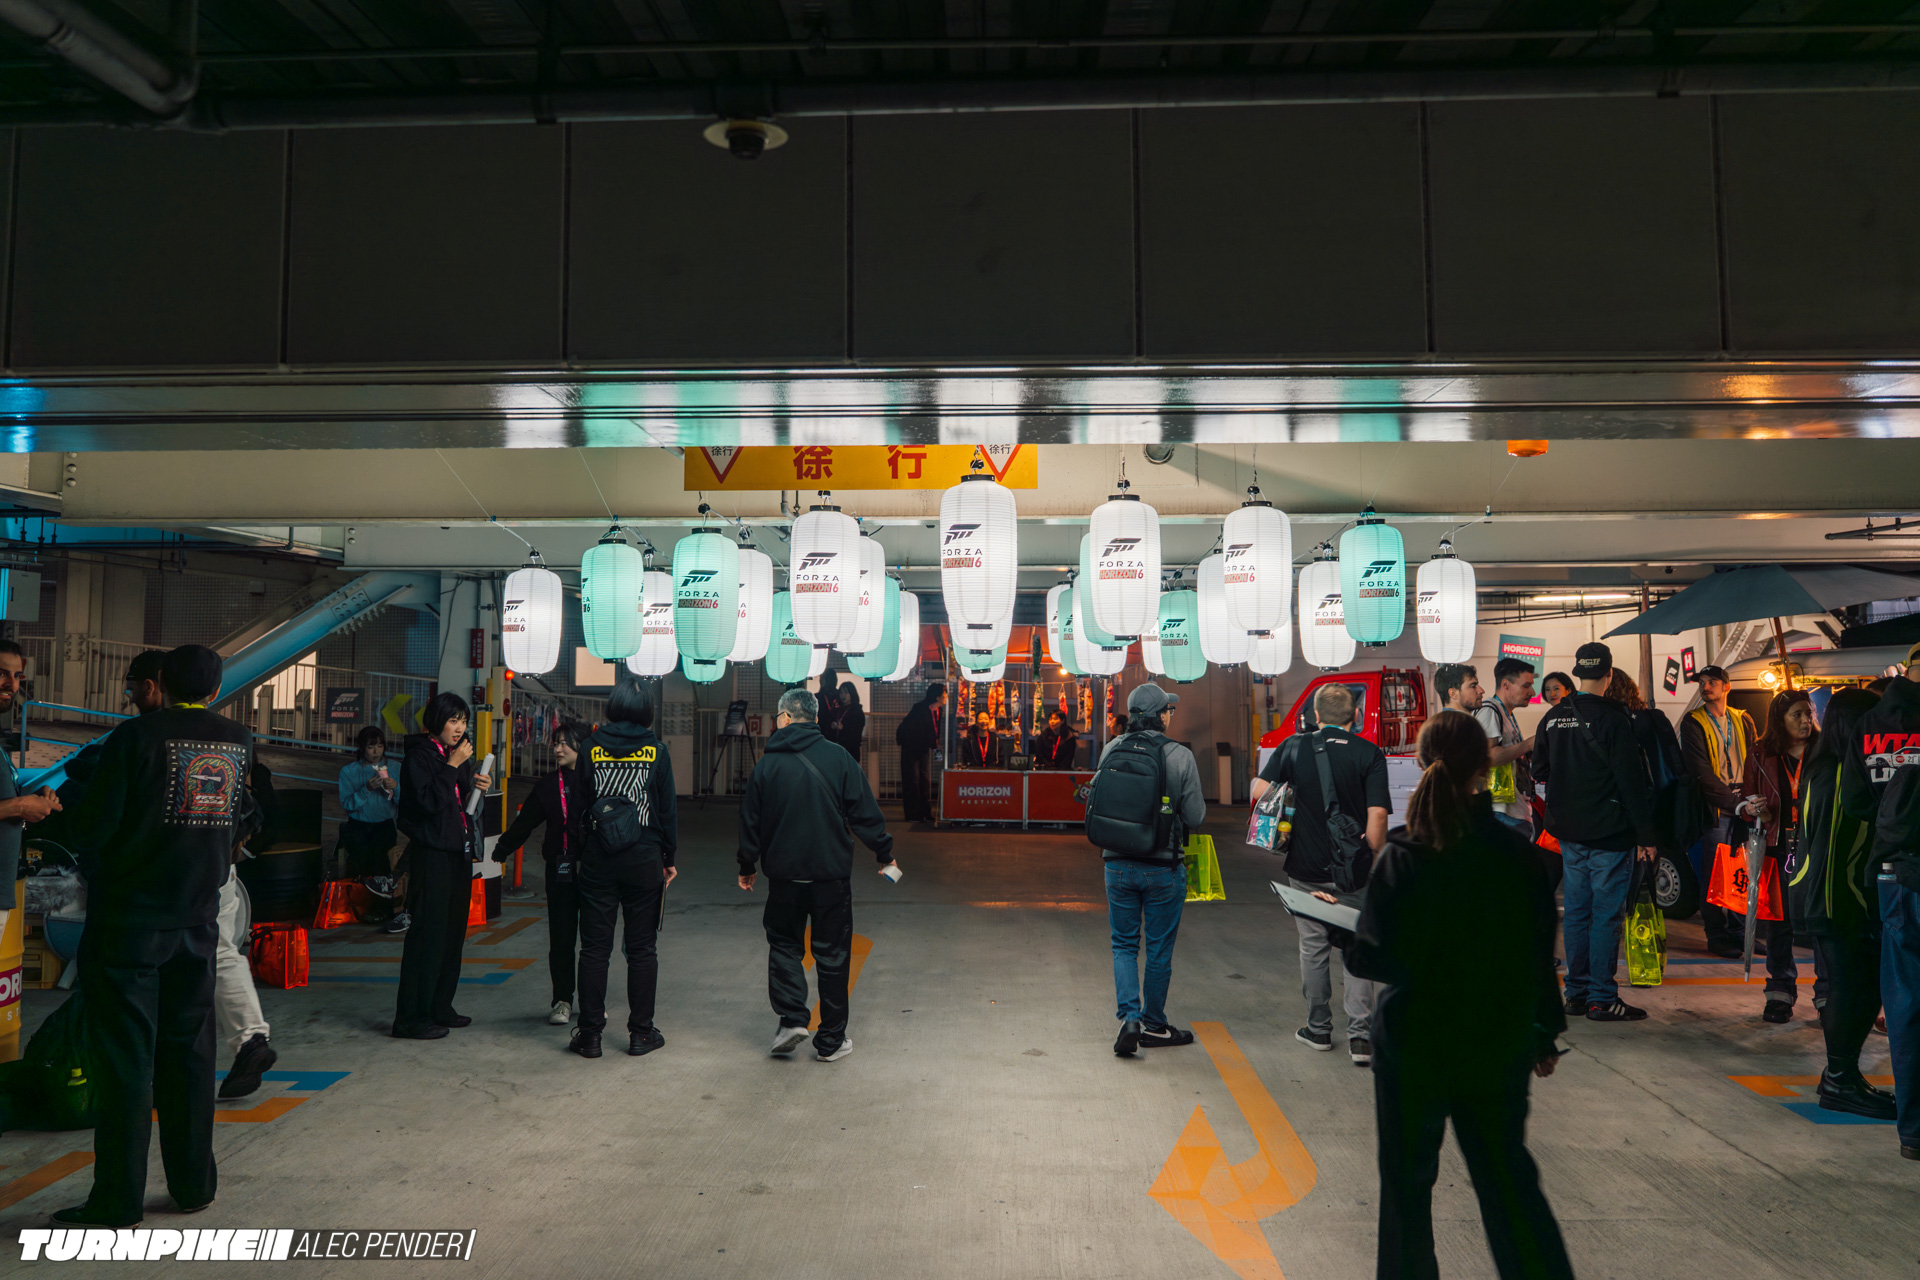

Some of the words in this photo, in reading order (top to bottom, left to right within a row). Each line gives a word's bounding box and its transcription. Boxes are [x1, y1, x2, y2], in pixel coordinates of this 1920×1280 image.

[975, 557, 982, 568] 6
[1138, 570, 1144, 579] 6
[1250, 573, 1256, 582] 6
[832, 583, 839, 592] 6
[1395, 588, 1400, 597] 6
[712, 600, 719, 609] 6
[1504, 644, 1542, 656] HORIZON
[594, 748, 654, 759] HOON
[959, 786, 1010, 796] HORIZON
